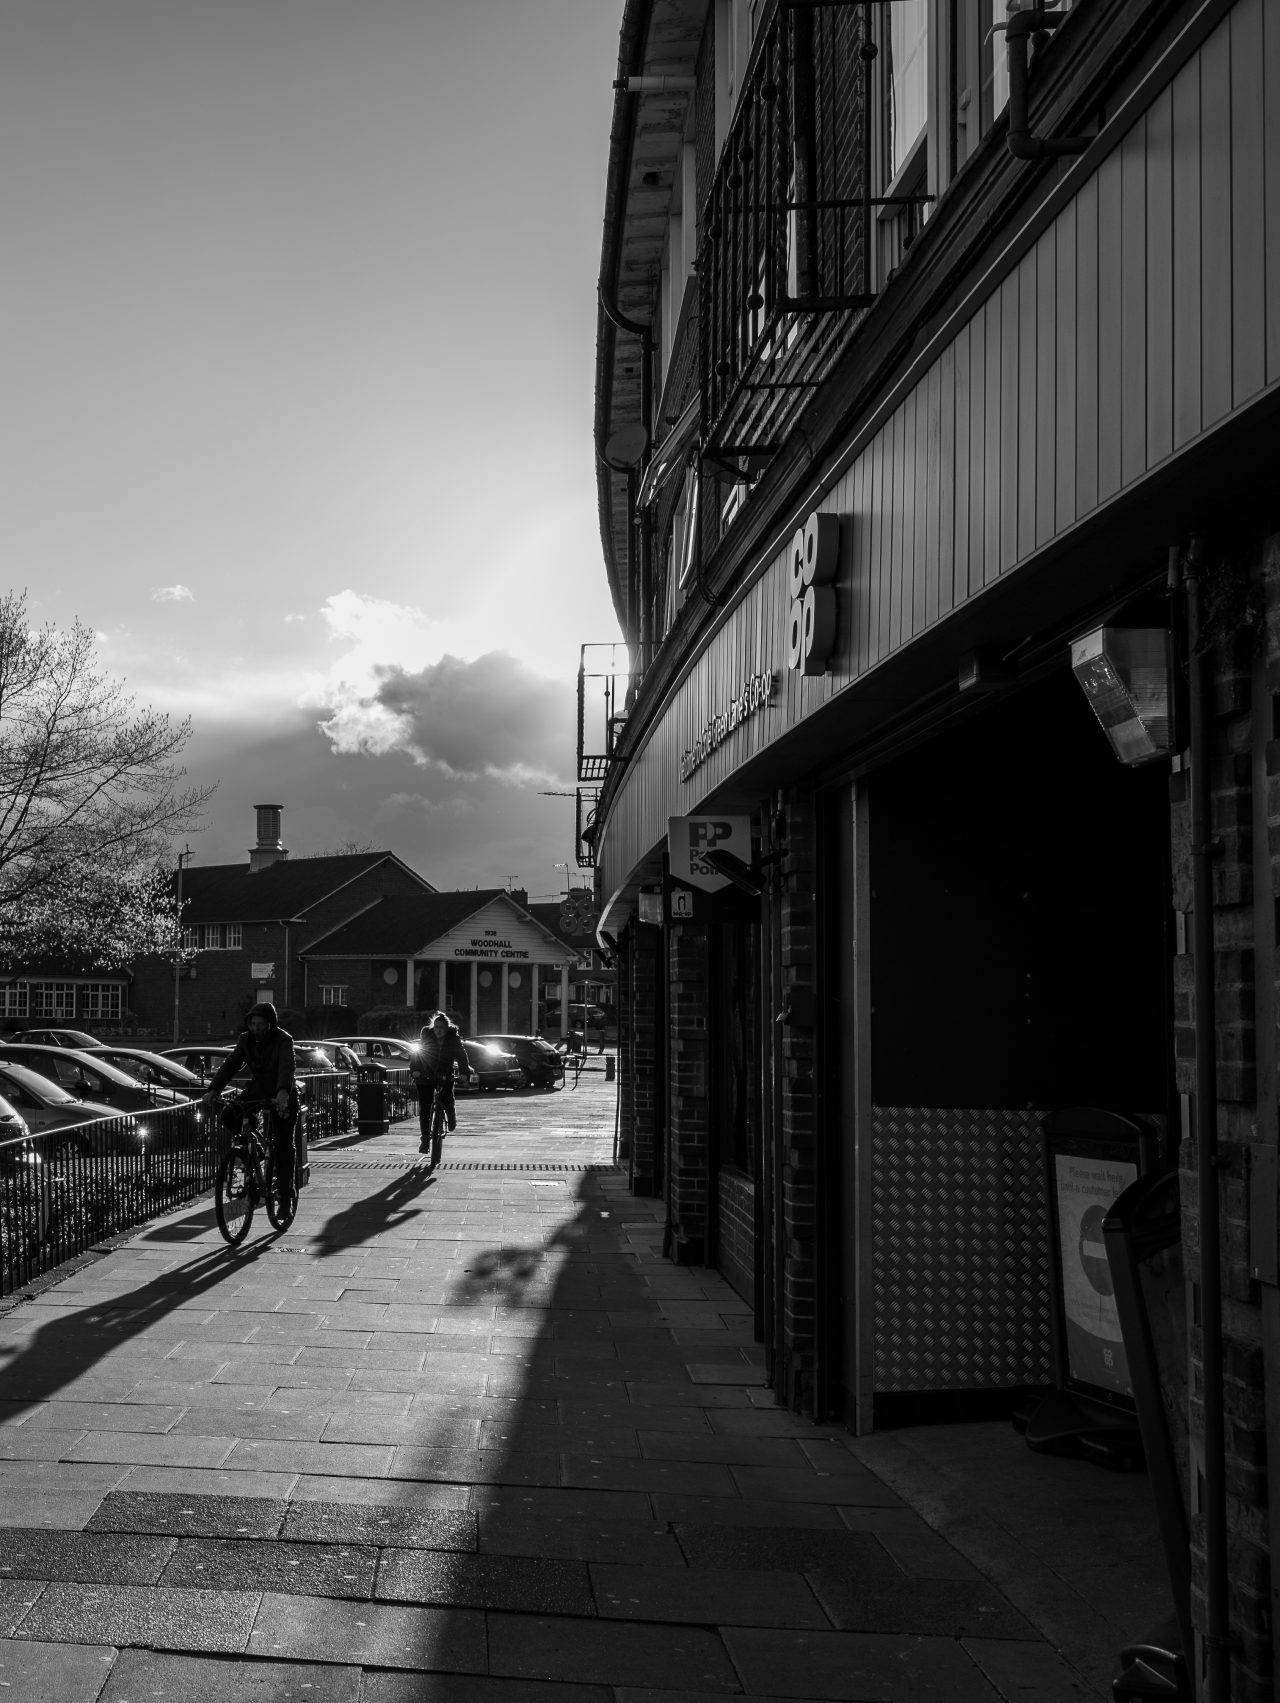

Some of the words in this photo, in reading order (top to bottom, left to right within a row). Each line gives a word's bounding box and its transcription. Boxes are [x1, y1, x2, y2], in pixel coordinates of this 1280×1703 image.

[728, 682, 748, 732] Lane's
[749, 668, 772, 712] Co-op
[470, 939, 513, 949] WOODHALL
[454, 948, 499, 958] COMMUNITY
[500, 950, 529, 959] CENTRE
